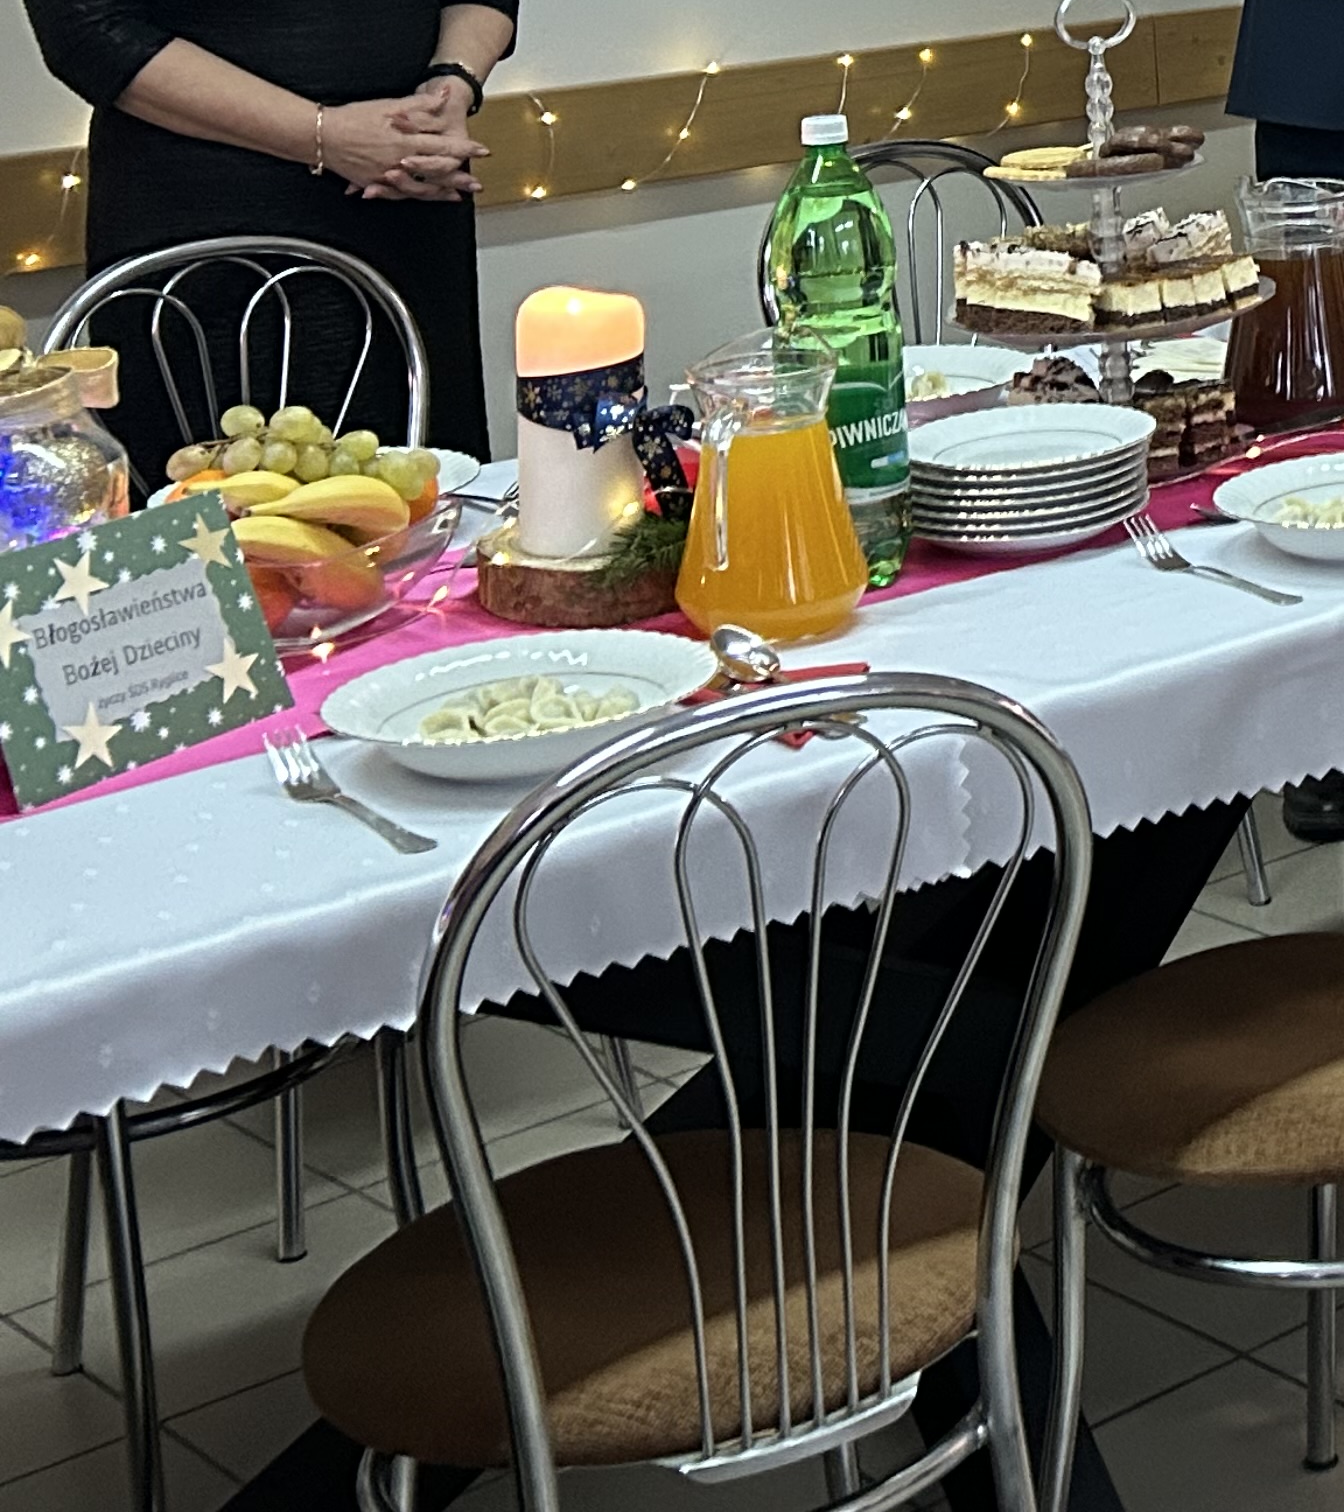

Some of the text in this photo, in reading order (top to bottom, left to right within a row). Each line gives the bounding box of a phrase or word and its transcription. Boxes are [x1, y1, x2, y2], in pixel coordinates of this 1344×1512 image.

[32, 582, 207, 649] Błogosławieństwa
[62, 627, 201, 685] Bożej Dzieciny
